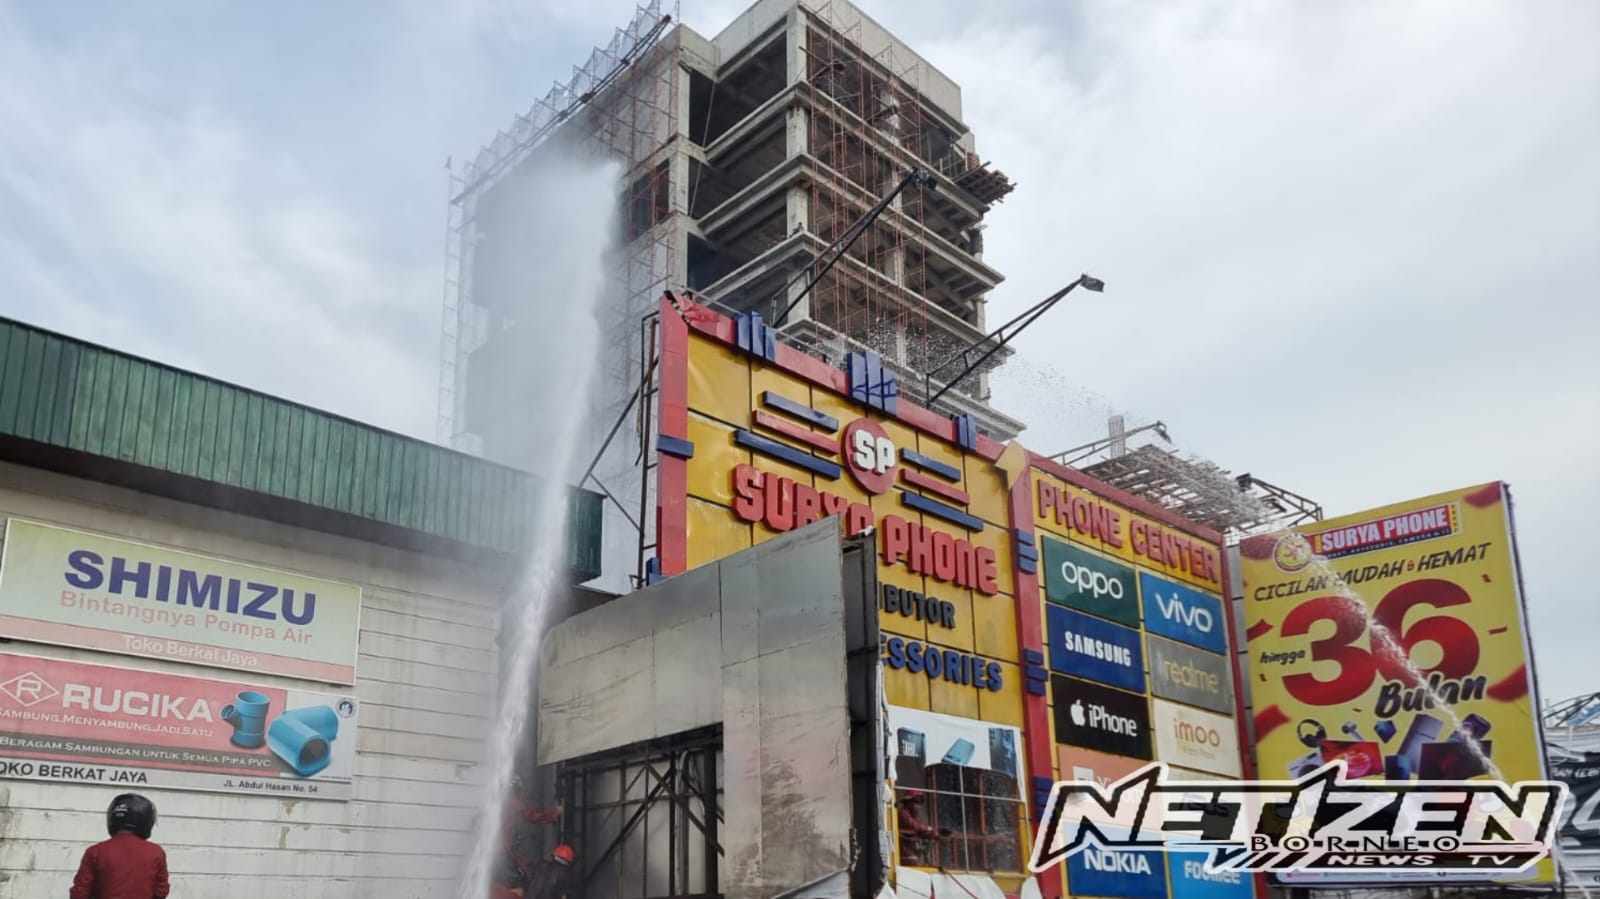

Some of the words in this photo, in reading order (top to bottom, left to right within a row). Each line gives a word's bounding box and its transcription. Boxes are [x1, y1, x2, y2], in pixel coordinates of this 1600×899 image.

[852, 429, 897, 475] SP
[1037, 479, 1123, 548] PHONE
[1130, 519, 1218, 583] CENTER
[1322, 523, 1381, 551] SURYA
[1384, 507, 1448, 538] PHONE
[882, 514, 998, 596] PHONE
[1254, 575, 1329, 601] CICILAN
[1334, 560, 1405, 586] MUDAH
[1418, 542, 1492, 571] HEMAT
[64, 550, 316, 626] SHIMIZU
[1061, 561, 1124, 599] oppo
[1155, 592, 1214, 633] vivo
[60, 590, 196, 628] Bintangnya
[204, 614, 276, 640] Pompa
[283, 628, 313, 645] Air
[122, 634, 165, 652] Toko
[167, 640, 219, 661] Berkat
[221, 648, 257, 668] Jaya
[1064, 631, 1132, 667] SAMSUNG
[1259, 649, 1306, 666] hingga
[1280, 578, 1480, 706] 36
[0, 707, 59, 722] AMBUNG
[62, 683, 213, 723] RUCIKA
[1374, 673, 1487, 719] Bulan
[1088, 704, 1138, 737] iPhone
[1173, 717, 1220, 747] imoo
[38, 764, 106, 780] BERKAT
[110, 770, 148, 784] JAYA
[64, 742, 141, 757] SAMBUNGAN
[248, 757, 272, 767] PVC
[238, 780, 264, 789] Abdul
[1084, 850, 1152, 875] NOKIA
